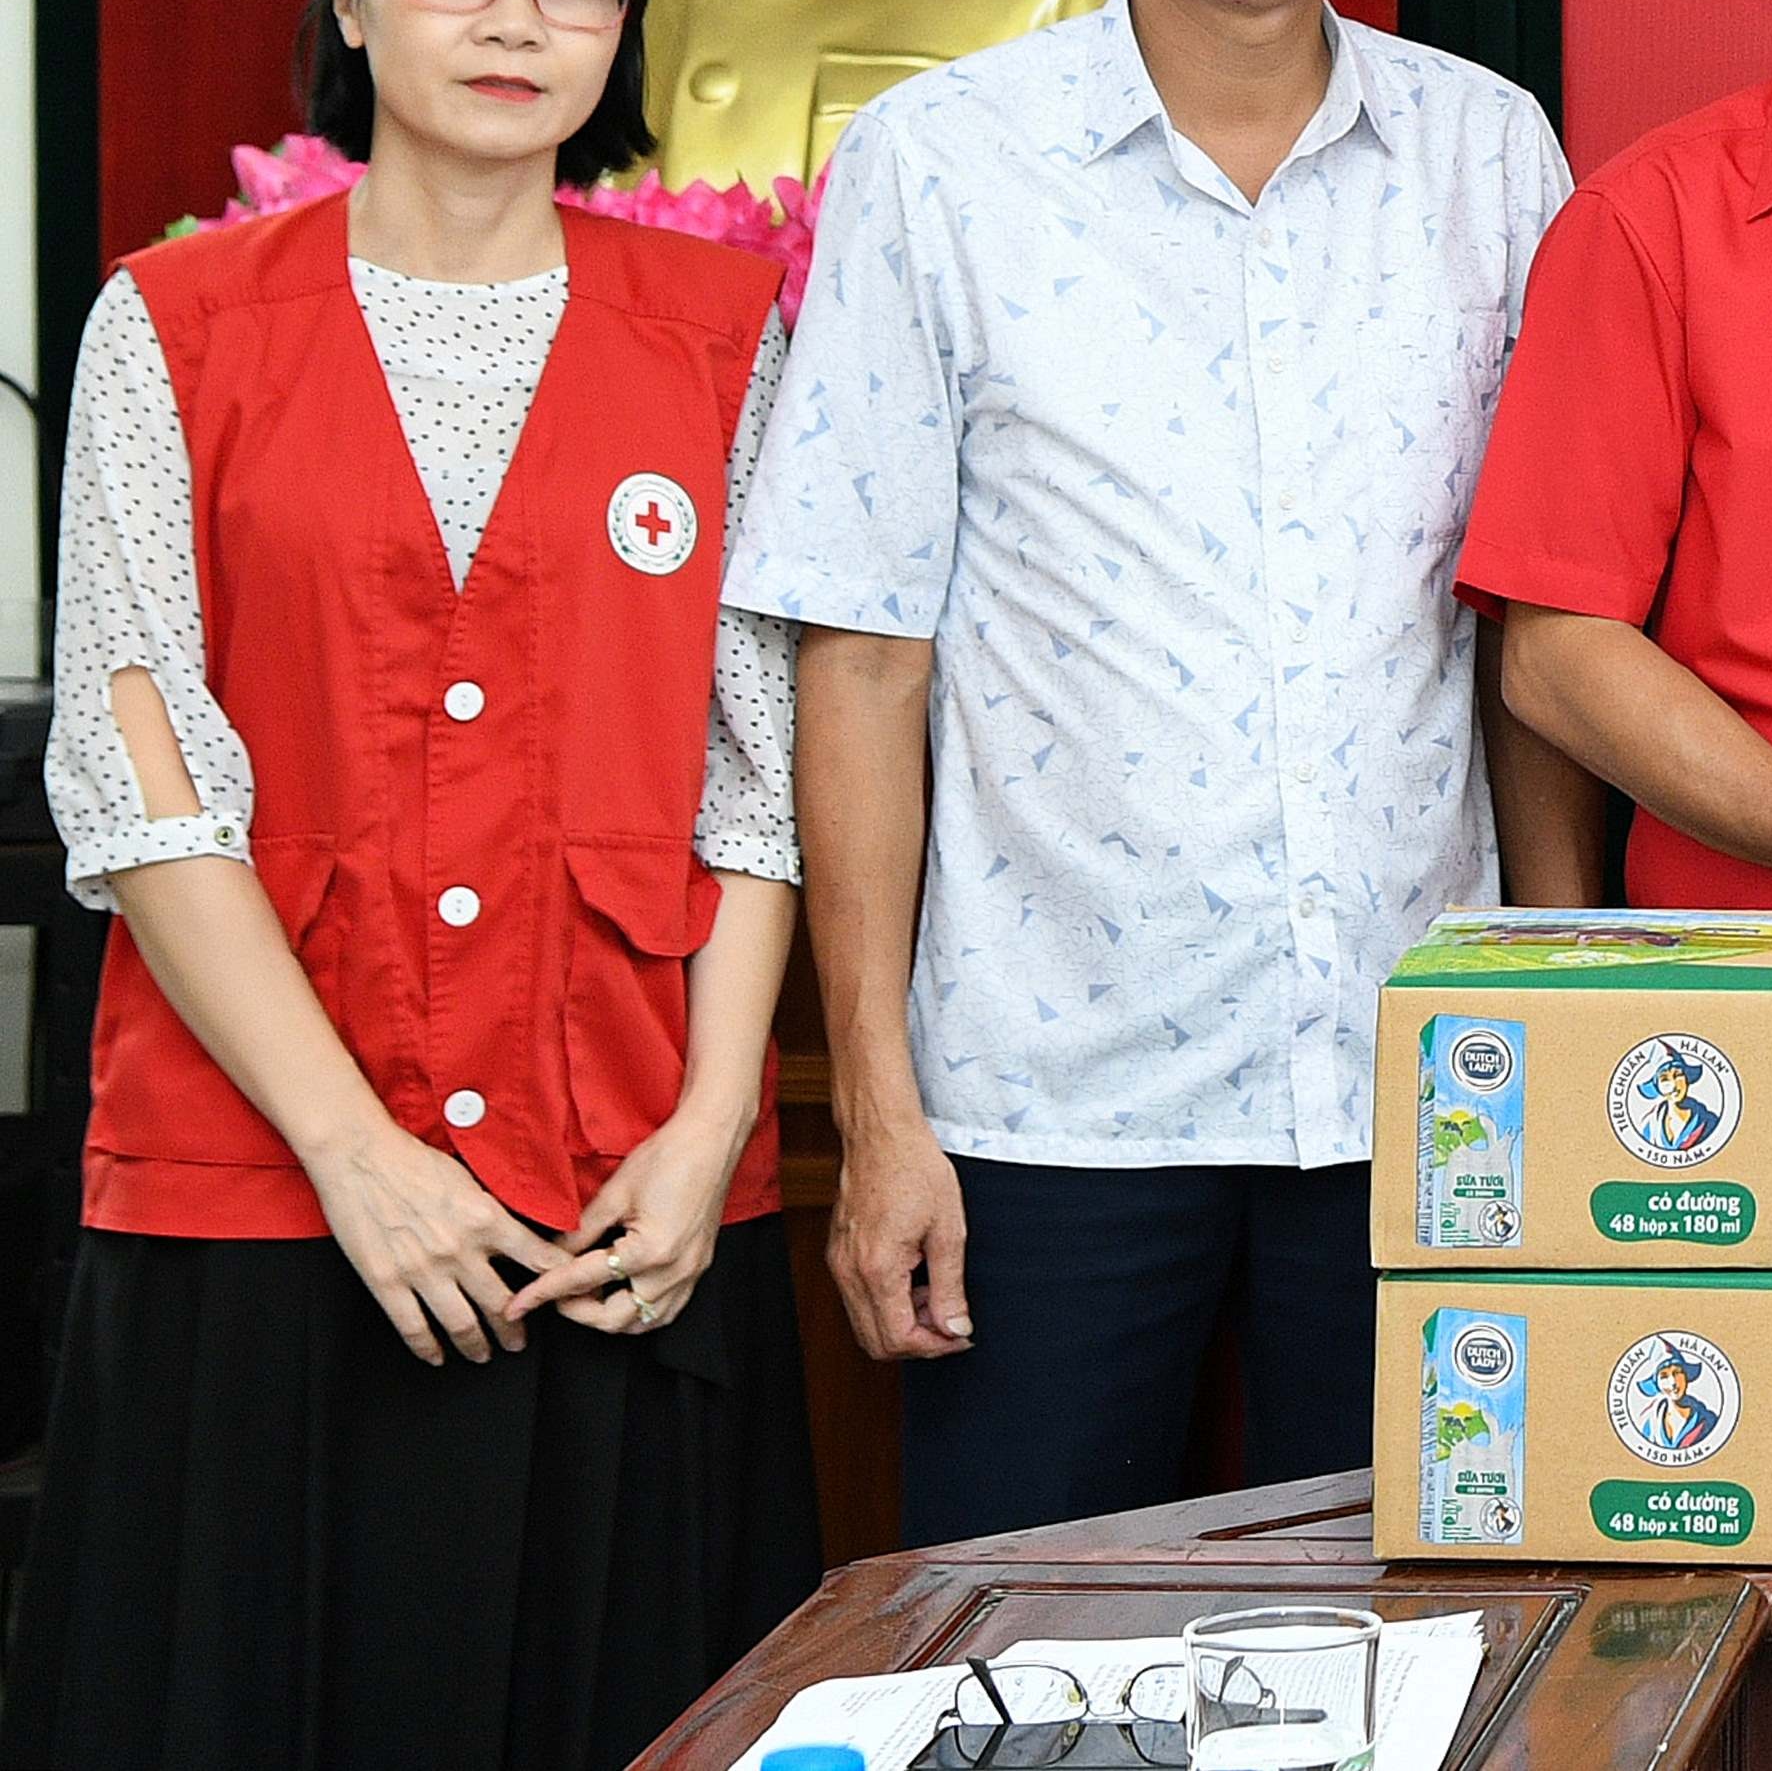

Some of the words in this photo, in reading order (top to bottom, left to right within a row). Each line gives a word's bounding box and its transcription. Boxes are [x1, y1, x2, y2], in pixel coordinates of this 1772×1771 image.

[1702, 1049, 1725, 1074] LAN
[1646, 1150, 1668, 1164] 150
[1648, 1192, 1672, 1211] có
[1676, 1190, 1740, 1216] đường
[1609, 1214, 1634, 1232] 48
[1640, 1216, 1668, 1236] hộp
[1668, 1221, 1678, 1232] x
[1684, 1215, 1718, 1233] 180
[1721, 1218, 1740, 1234] ml
[1648, 1491, 1671, 1510] có
[1676, 1490, 1739, 1516] đường
[1609, 1513, 1634, 1532] 48
[1639, 1515, 1667, 1535] hộp
[1667, 1521, 1678, 1532] x
[1683, 1515, 1717, 1533] 180
[1720, 1519, 1739, 1534] ml
